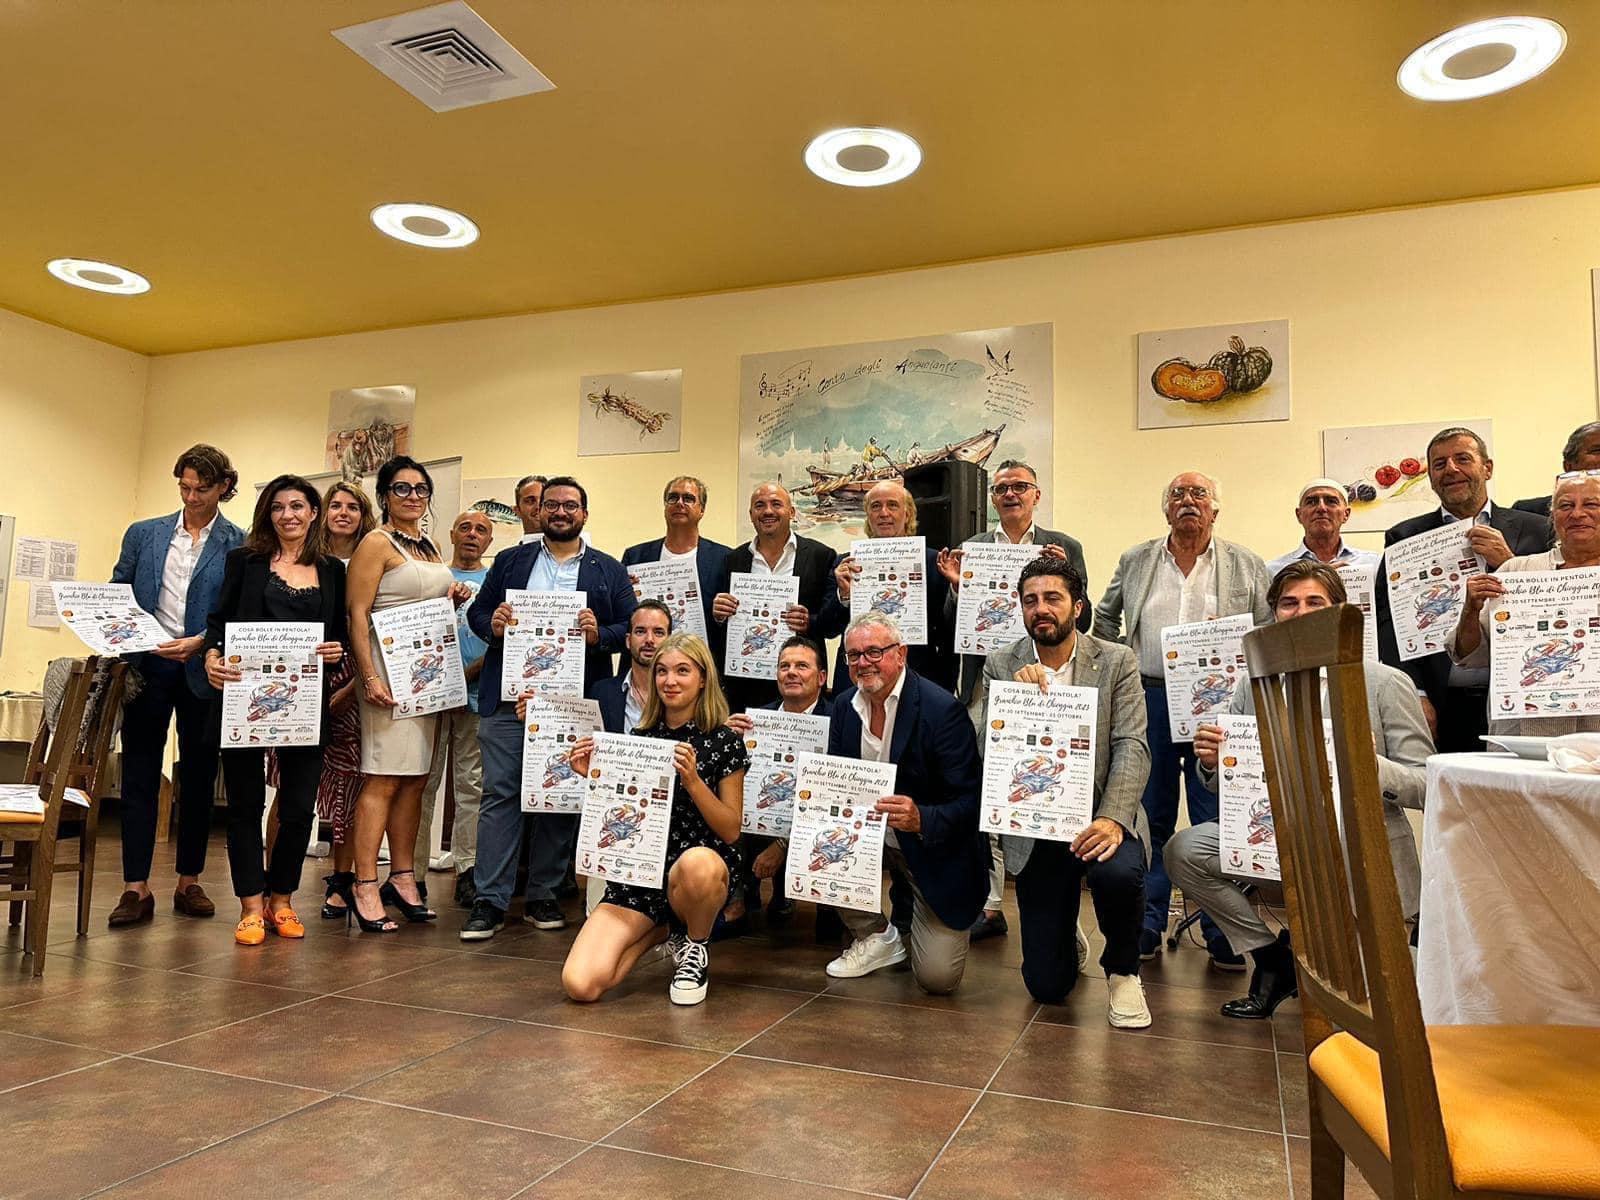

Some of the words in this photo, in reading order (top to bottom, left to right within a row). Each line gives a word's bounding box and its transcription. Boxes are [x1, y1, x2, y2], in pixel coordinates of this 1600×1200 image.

[855, 358, 882, 376] degli
[1502, 585, 1527, 595] anchio
[1529, 586, 1545, 594] Blu
[1557, 582, 1589, 593] Chioggia
[230, 633, 256, 643] Granchio
[279, 633, 303, 643] Chioggia
[994, 695, 1021, 705] Granchio
[1023, 698, 1035, 706] Blu
[1046, 698, 1073, 711] Chioggia
[1224, 729, 1253, 741] Granchio
[802, 766, 826, 776] Granchio
[828, 770, 839, 778] Blu
[848, 773, 872, 785] Chioggia
